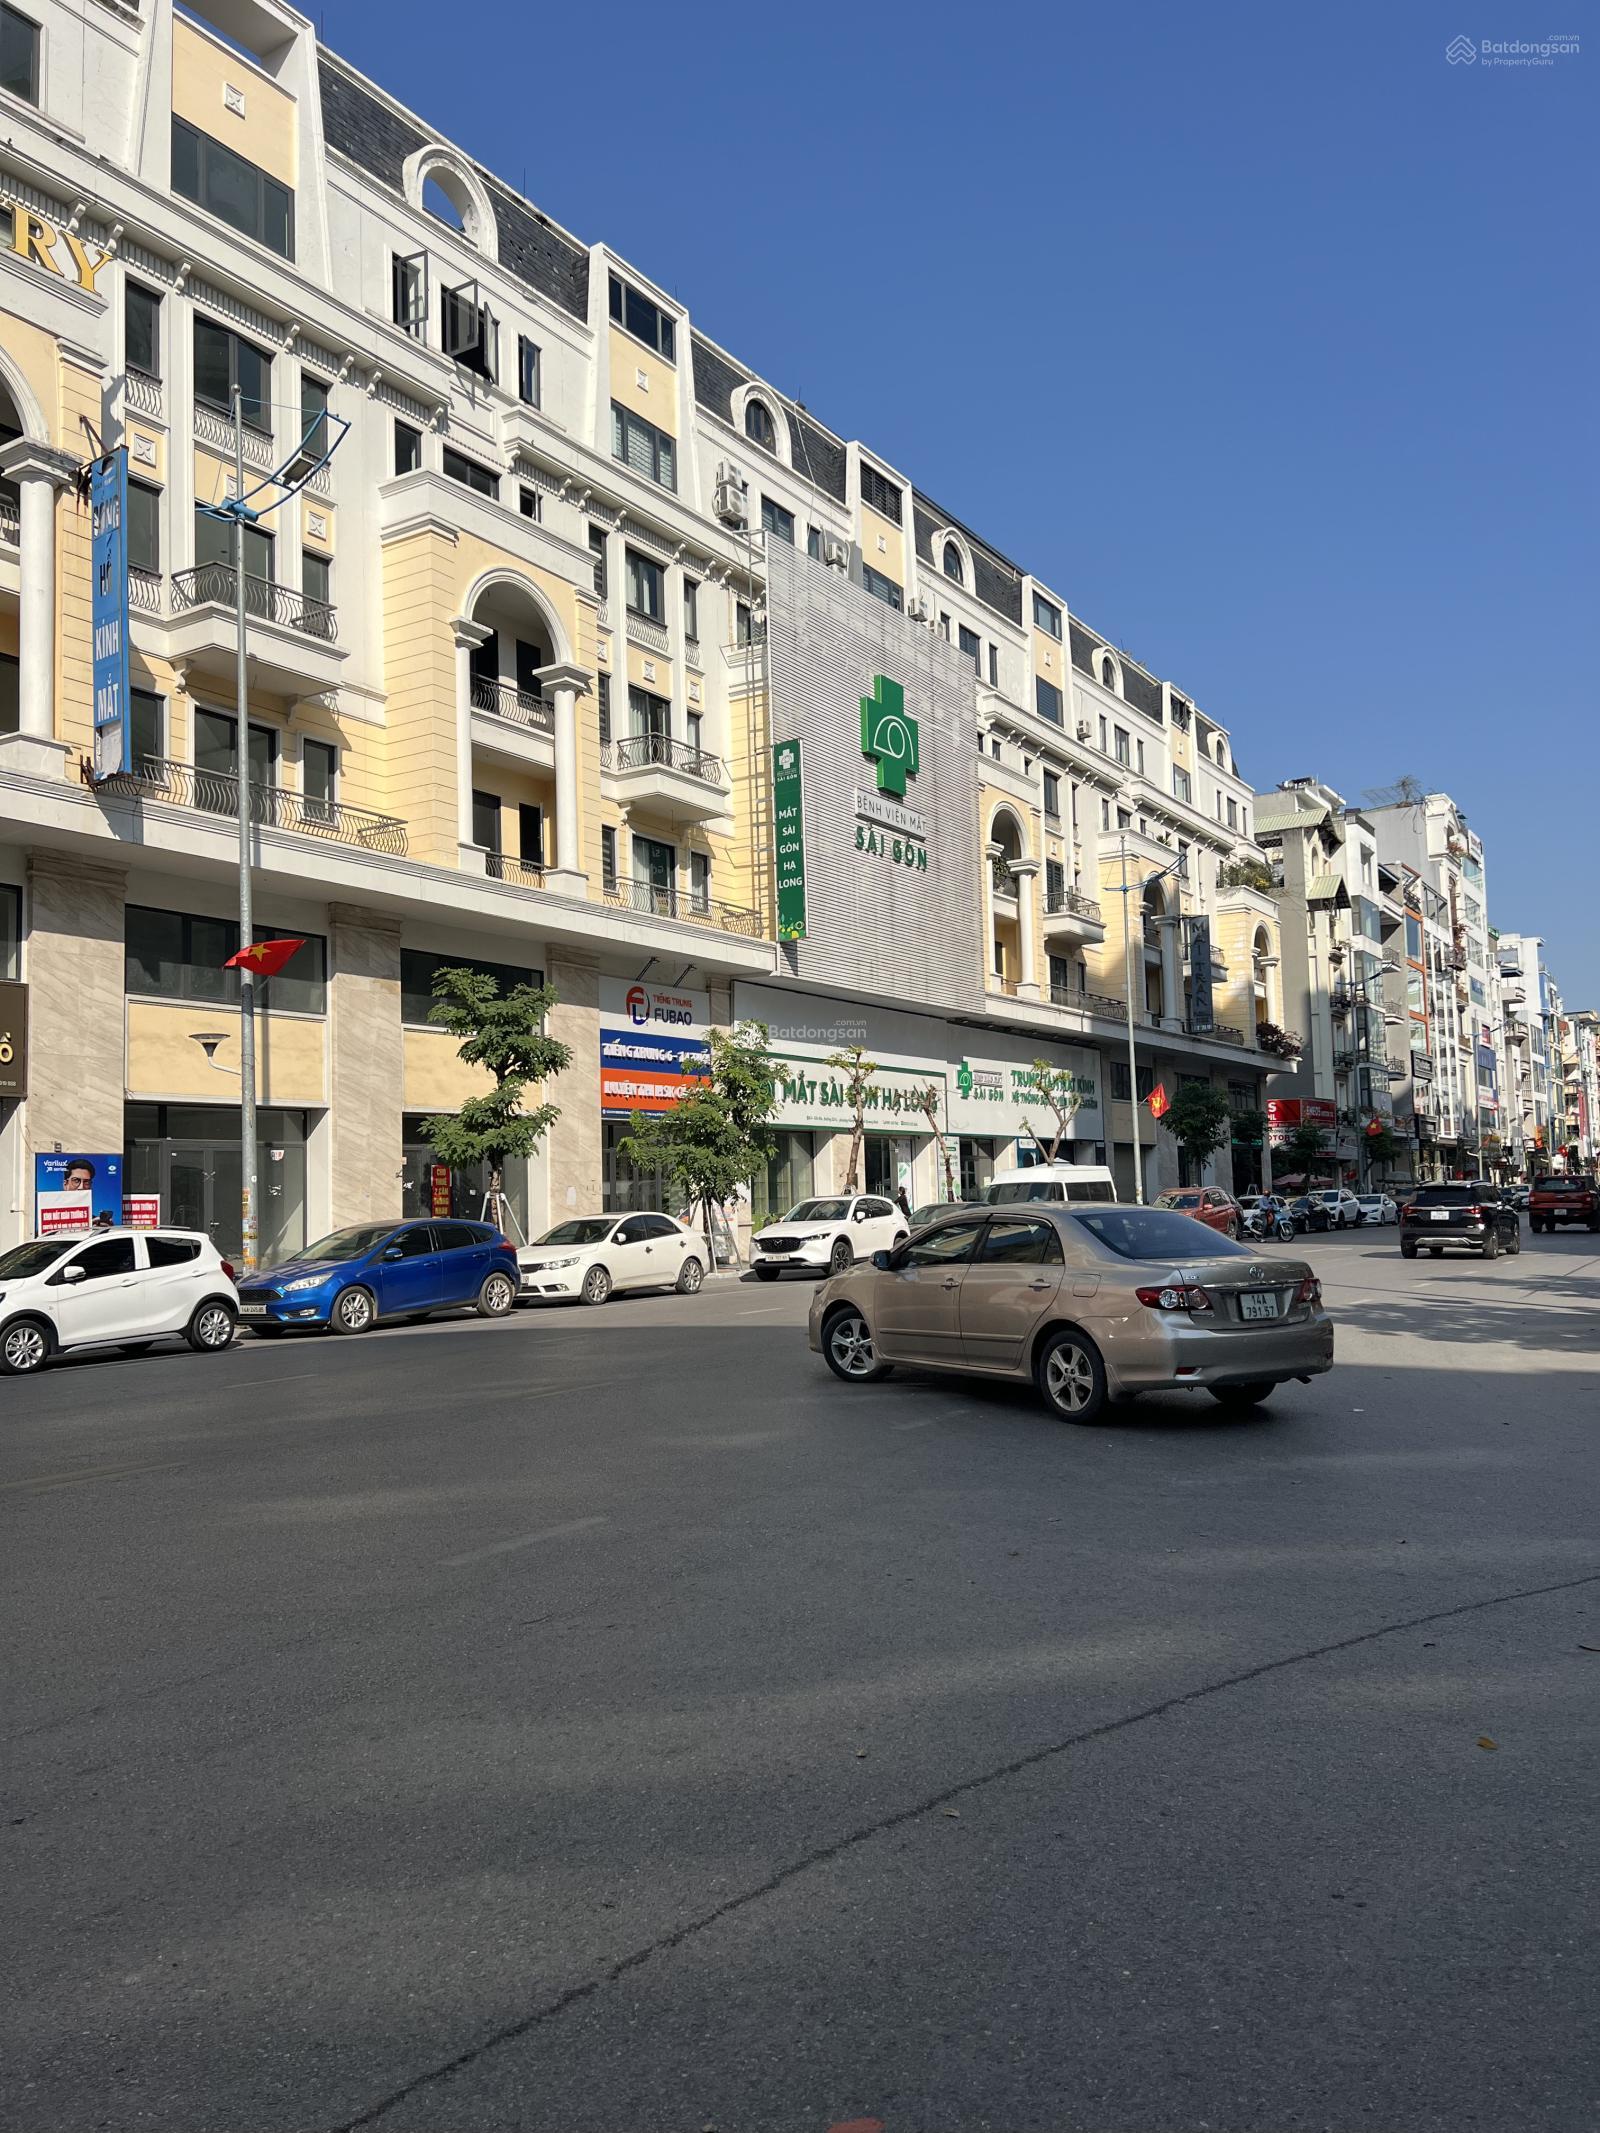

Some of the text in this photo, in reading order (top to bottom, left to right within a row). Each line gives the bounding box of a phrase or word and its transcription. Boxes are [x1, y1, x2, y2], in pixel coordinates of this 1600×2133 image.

[0, 197, 114, 298] RY
[95, 619, 119, 661] KÍNH
[97, 673, 119, 722] MẮT
[778, 806, 798, 820] MẮT
[782, 824, 796, 836] SÀI
[779, 841, 800, 854] GÒN
[855, 821, 927, 872] SÀI GÒN
[783, 860, 797, 872] HẠ
[778, 876, 803, 889] LONG
[652, 992, 693, 1008] TIẾNG TRUNG
[654, 1007, 693, 1026] FUBAO
[783, 1069, 817, 1105] MẮT
[819, 1076, 844, 1106] SÀI
[1251, 1294, 1267, 1305] 14A
[1246, 1305, 1275, 1318] 791.57
